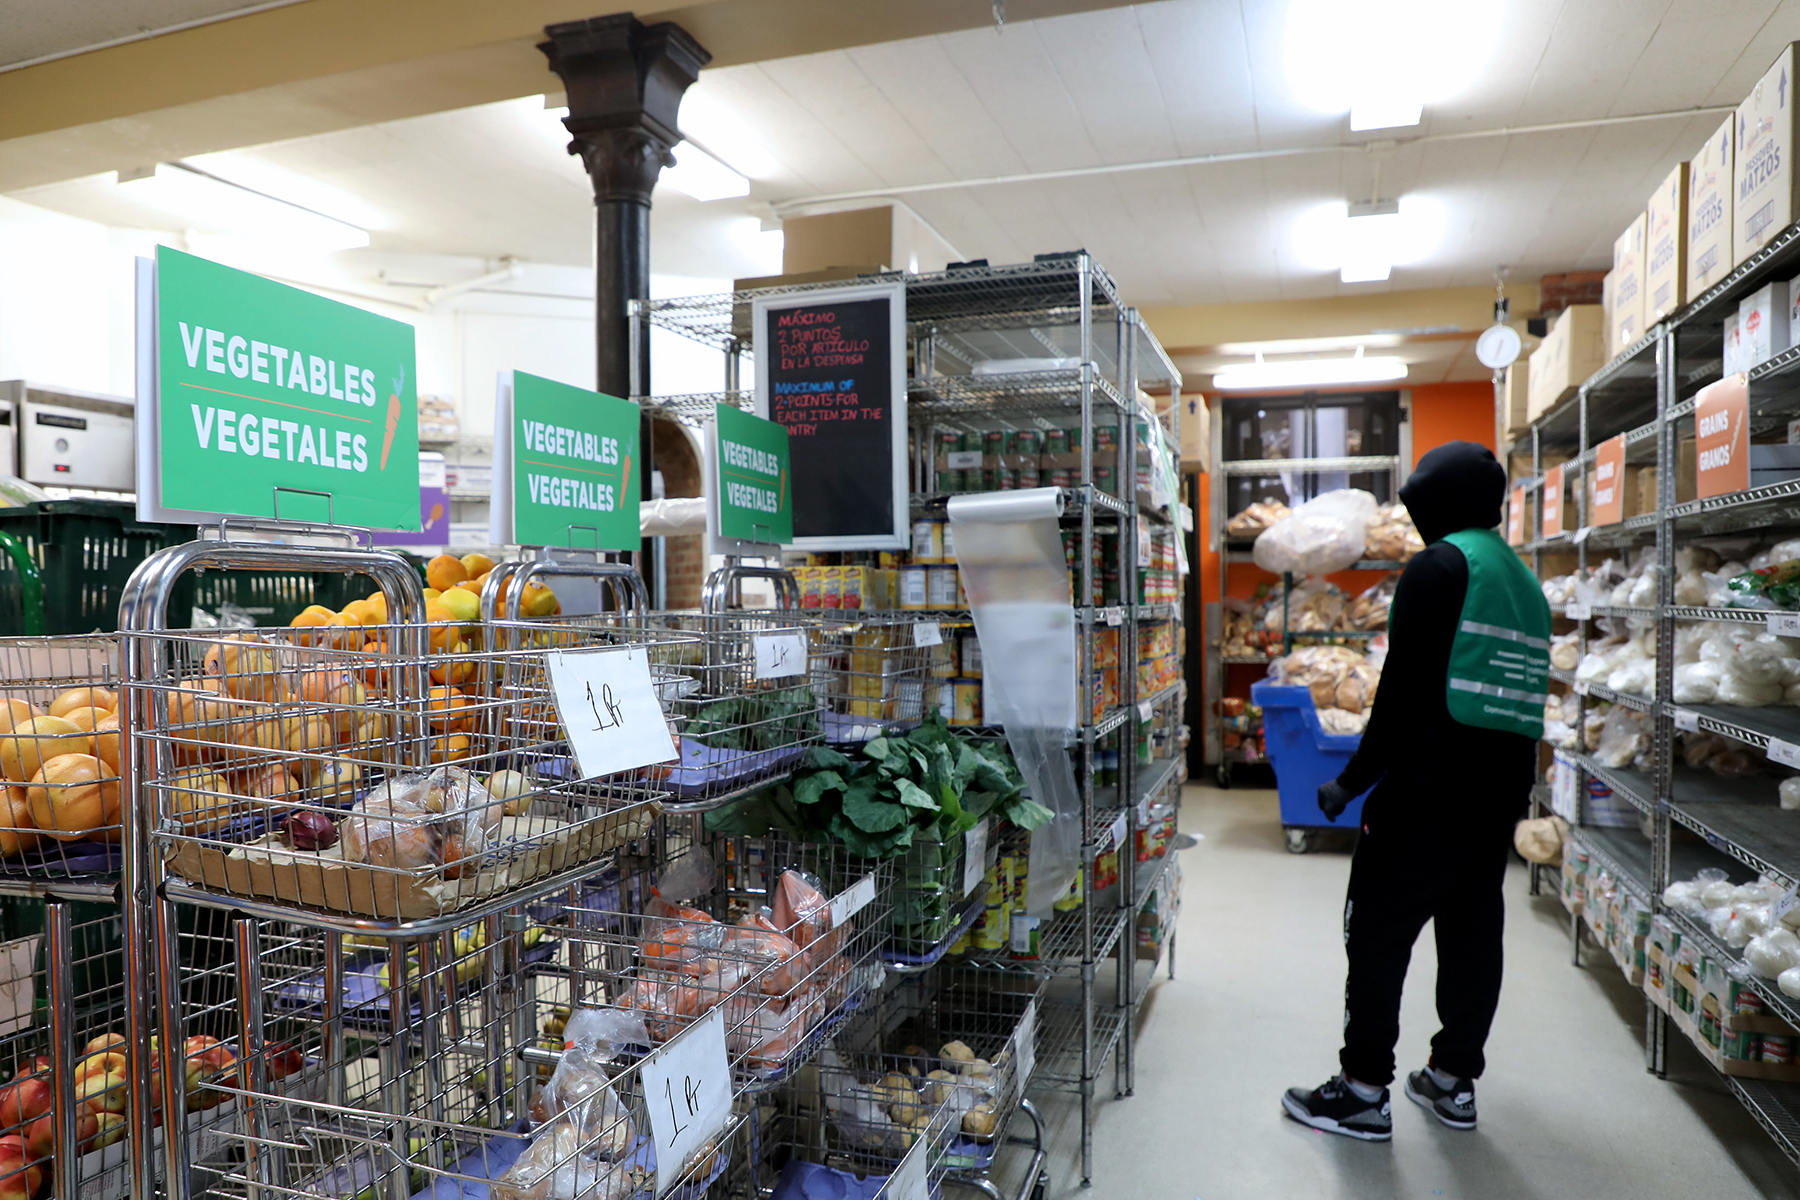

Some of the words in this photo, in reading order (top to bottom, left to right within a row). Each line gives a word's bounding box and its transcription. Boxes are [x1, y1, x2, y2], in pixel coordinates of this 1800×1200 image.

[1740, 145, 1780, 201] MATZOS
[1692, 199, 1722, 242] MATZOS
[779, 310, 836, 327] MÁXIMO
[779, 330, 787, 344] 2
[792, 326, 841, 343] PUNTOS
[782, 343, 807, 357] POR
[178, 321, 377, 407] VEGETABLES
[782, 358, 796, 370] EN
[799, 357, 811, 368] LA
[814, 355, 864, 367] DESPENSA
[775, 382, 835, 394] MAXIMUM
[839, 380, 855, 392] OF
[776, 396, 785, 410] 2
[787, 394, 833, 409] POINTS
[837, 393, 859, 406] FOR
[778, 411, 807, 424] EACH
[810, 410, 839, 421] ITEM
[842, 410, 857, 421] IN
[861, 408, 883, 420] THE
[1699, 409, 1729, 439] GRAINS
[190, 403, 368, 473] VEGETALES
[522, 419, 618, 466] VEGETABLES
[722, 439, 779, 477] VEGETABLES
[1699, 443, 1731, 472] GRANOS
[528, 473, 615, 512] VEGETALES
[726, 481, 778, 514] VEGETALES
